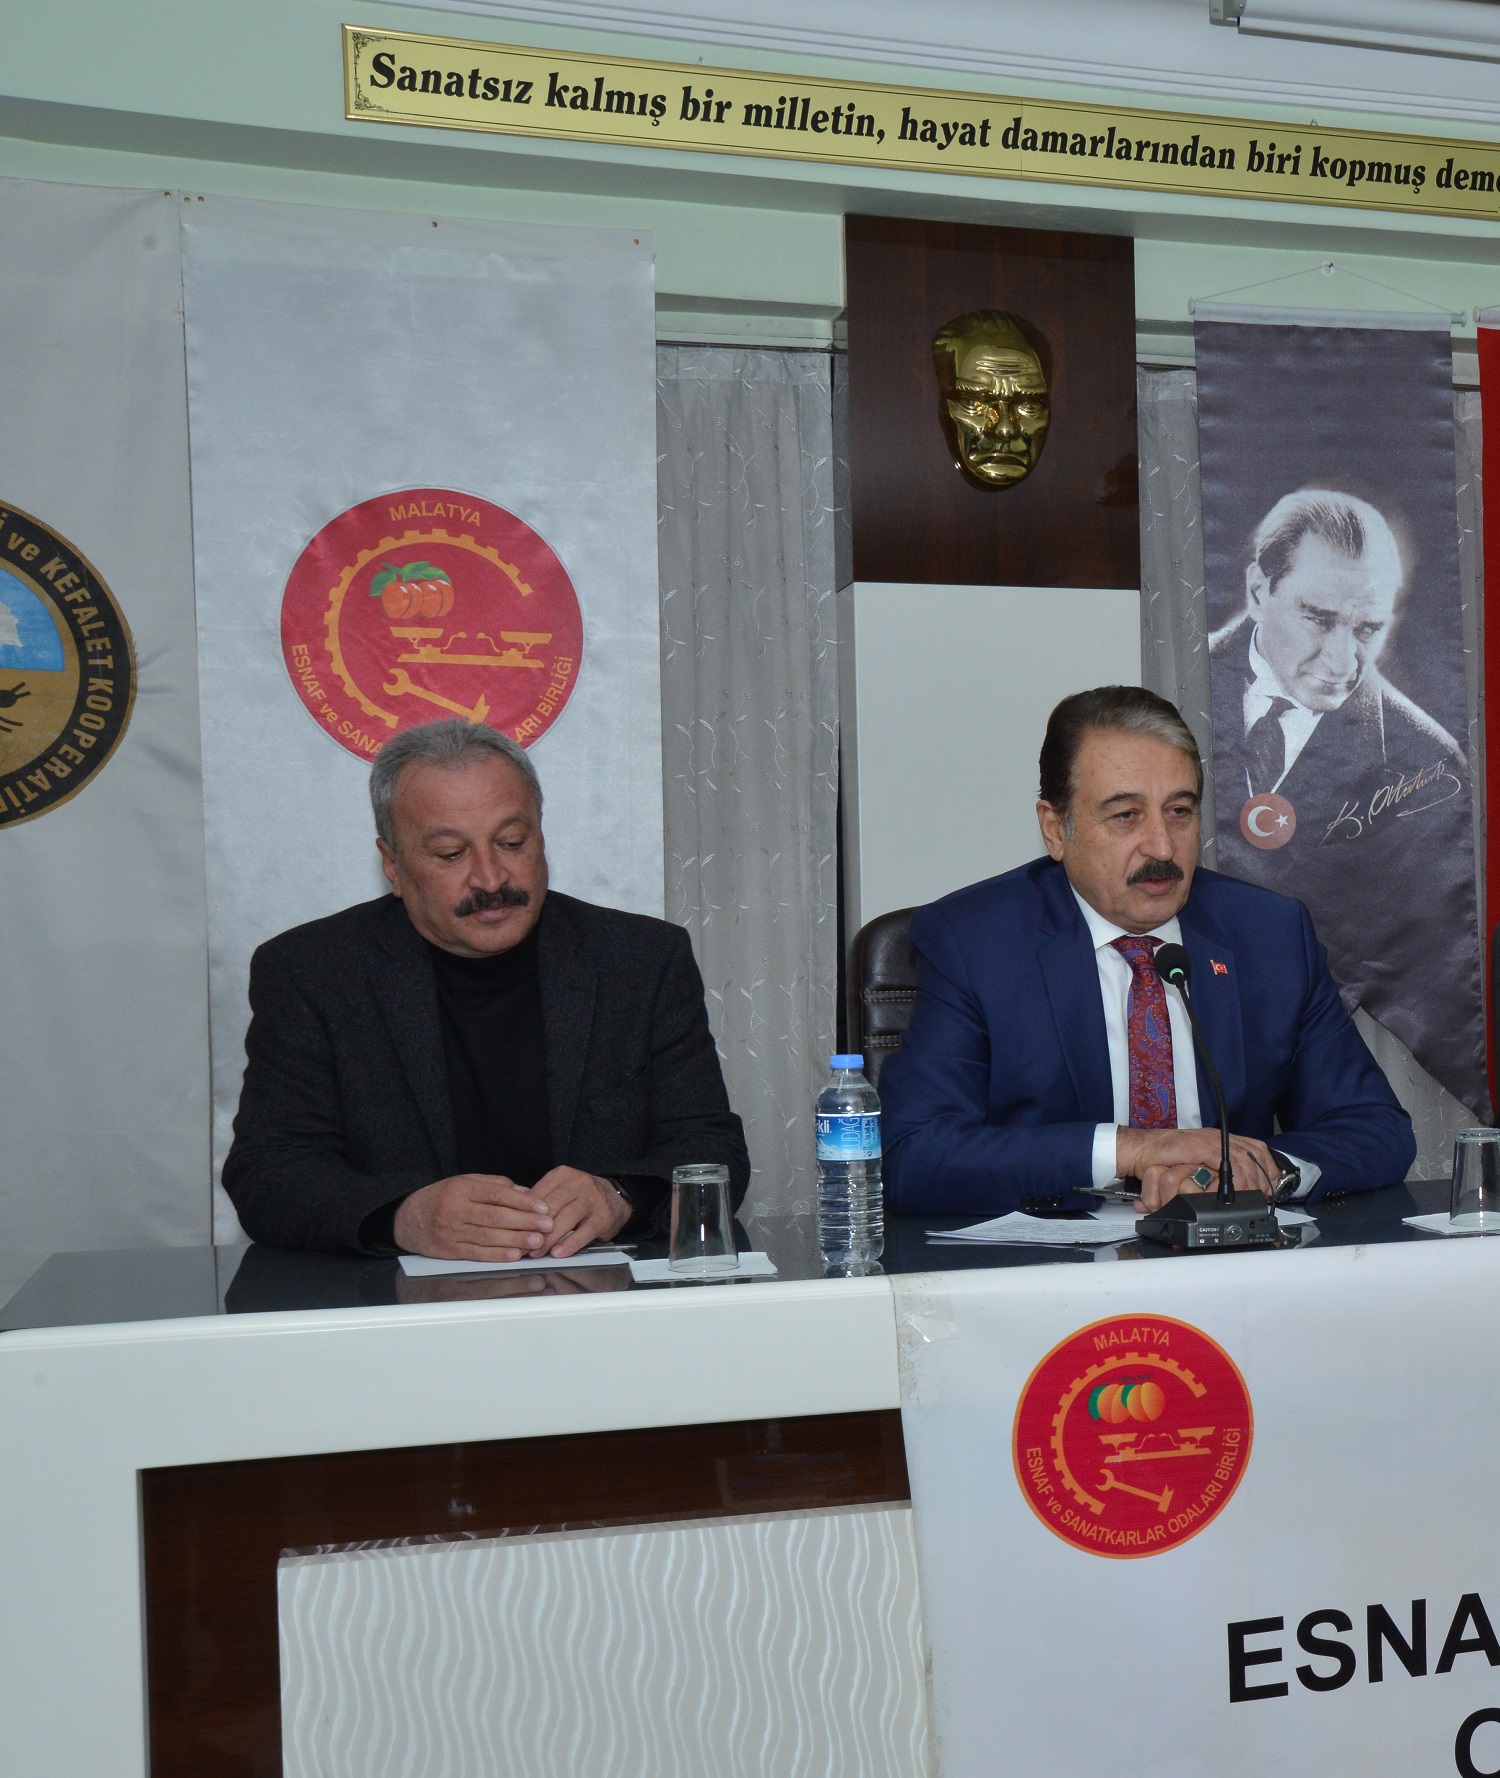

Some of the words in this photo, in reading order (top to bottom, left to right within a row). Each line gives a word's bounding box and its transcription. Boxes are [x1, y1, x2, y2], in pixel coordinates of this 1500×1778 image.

[370, 52, 534, 105] Sanatsız
[544, 72, 667, 127] kalmış
[679, 85, 733, 124] bir
[741, 95, 885, 145] milletin,
[897, 106, 992, 151] hayat
[1001, 116, 1237, 170] damarlarından
[1246, 139, 1302, 177] biri
[1309, 145, 1426, 195] kopmuş
[7, 532, 40, 561] ve
[388, 501, 481, 527] MALATYA
[39, 556, 114, 671] KEFALET
[291, 644, 327, 700] ESNAF
[320, 702, 338, 723] ve
[536, 656, 573, 717] BİRLİĞİ
[0, 677, 113, 814] KOOPERATİ
[1093, 1327, 1171, 1352] MALATYA
[1026, 1446, 1056, 1499] ESNAF
[1046, 1497, 1062, 1515] ve
[1060, 1509, 1167, 1546] SANATKARLAR
[1167, 1481, 1224, 1534] ODALARI
[1215, 1428, 1241, 1482] BİRLİĞİ
